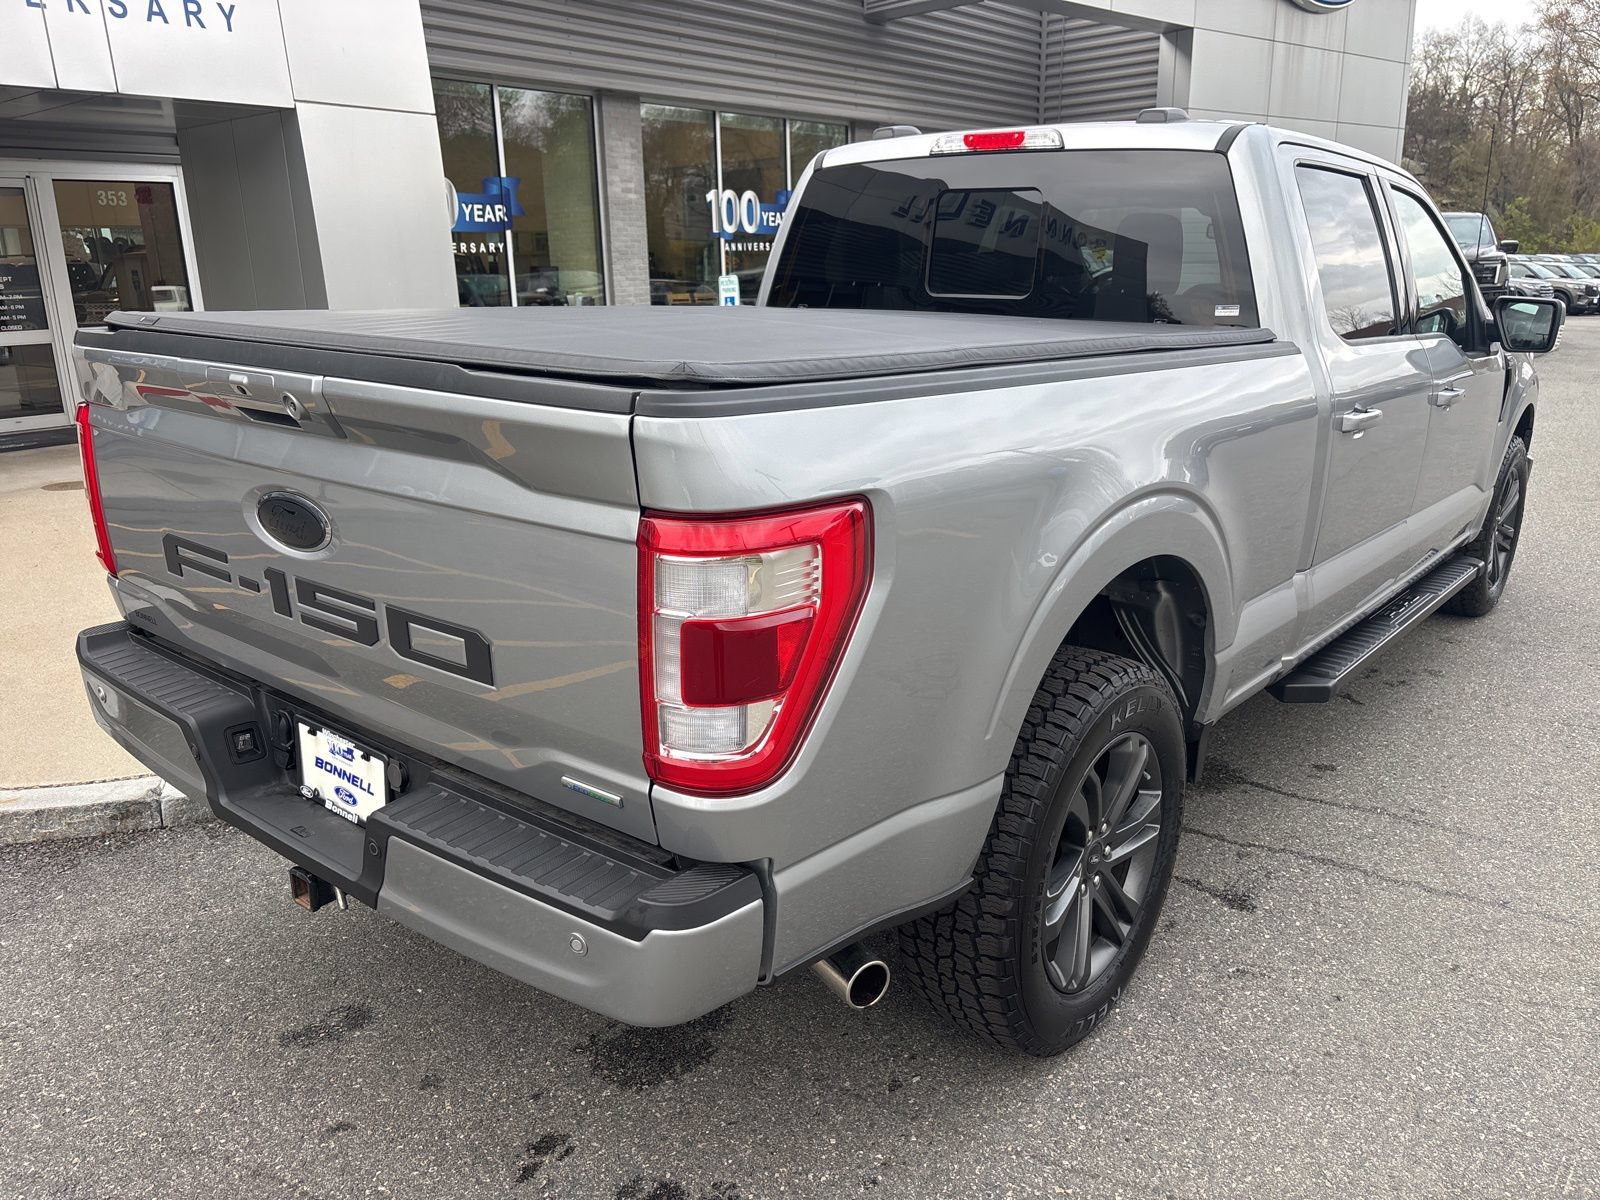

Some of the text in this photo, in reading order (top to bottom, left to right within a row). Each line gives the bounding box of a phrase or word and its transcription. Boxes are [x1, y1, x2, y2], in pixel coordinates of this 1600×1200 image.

[97, 190, 128, 207] 353
[461, 203, 508, 222] YEAR
[705, 189, 785, 234] 100 YEA
[724, 242, 775, 252] ANNIVERS
[162, 532, 497, 690] F-150
[314, 755, 375, 797] BONNELL
[338, 789, 354, 805] Ford
[324, 799, 359, 824] Bonnell
